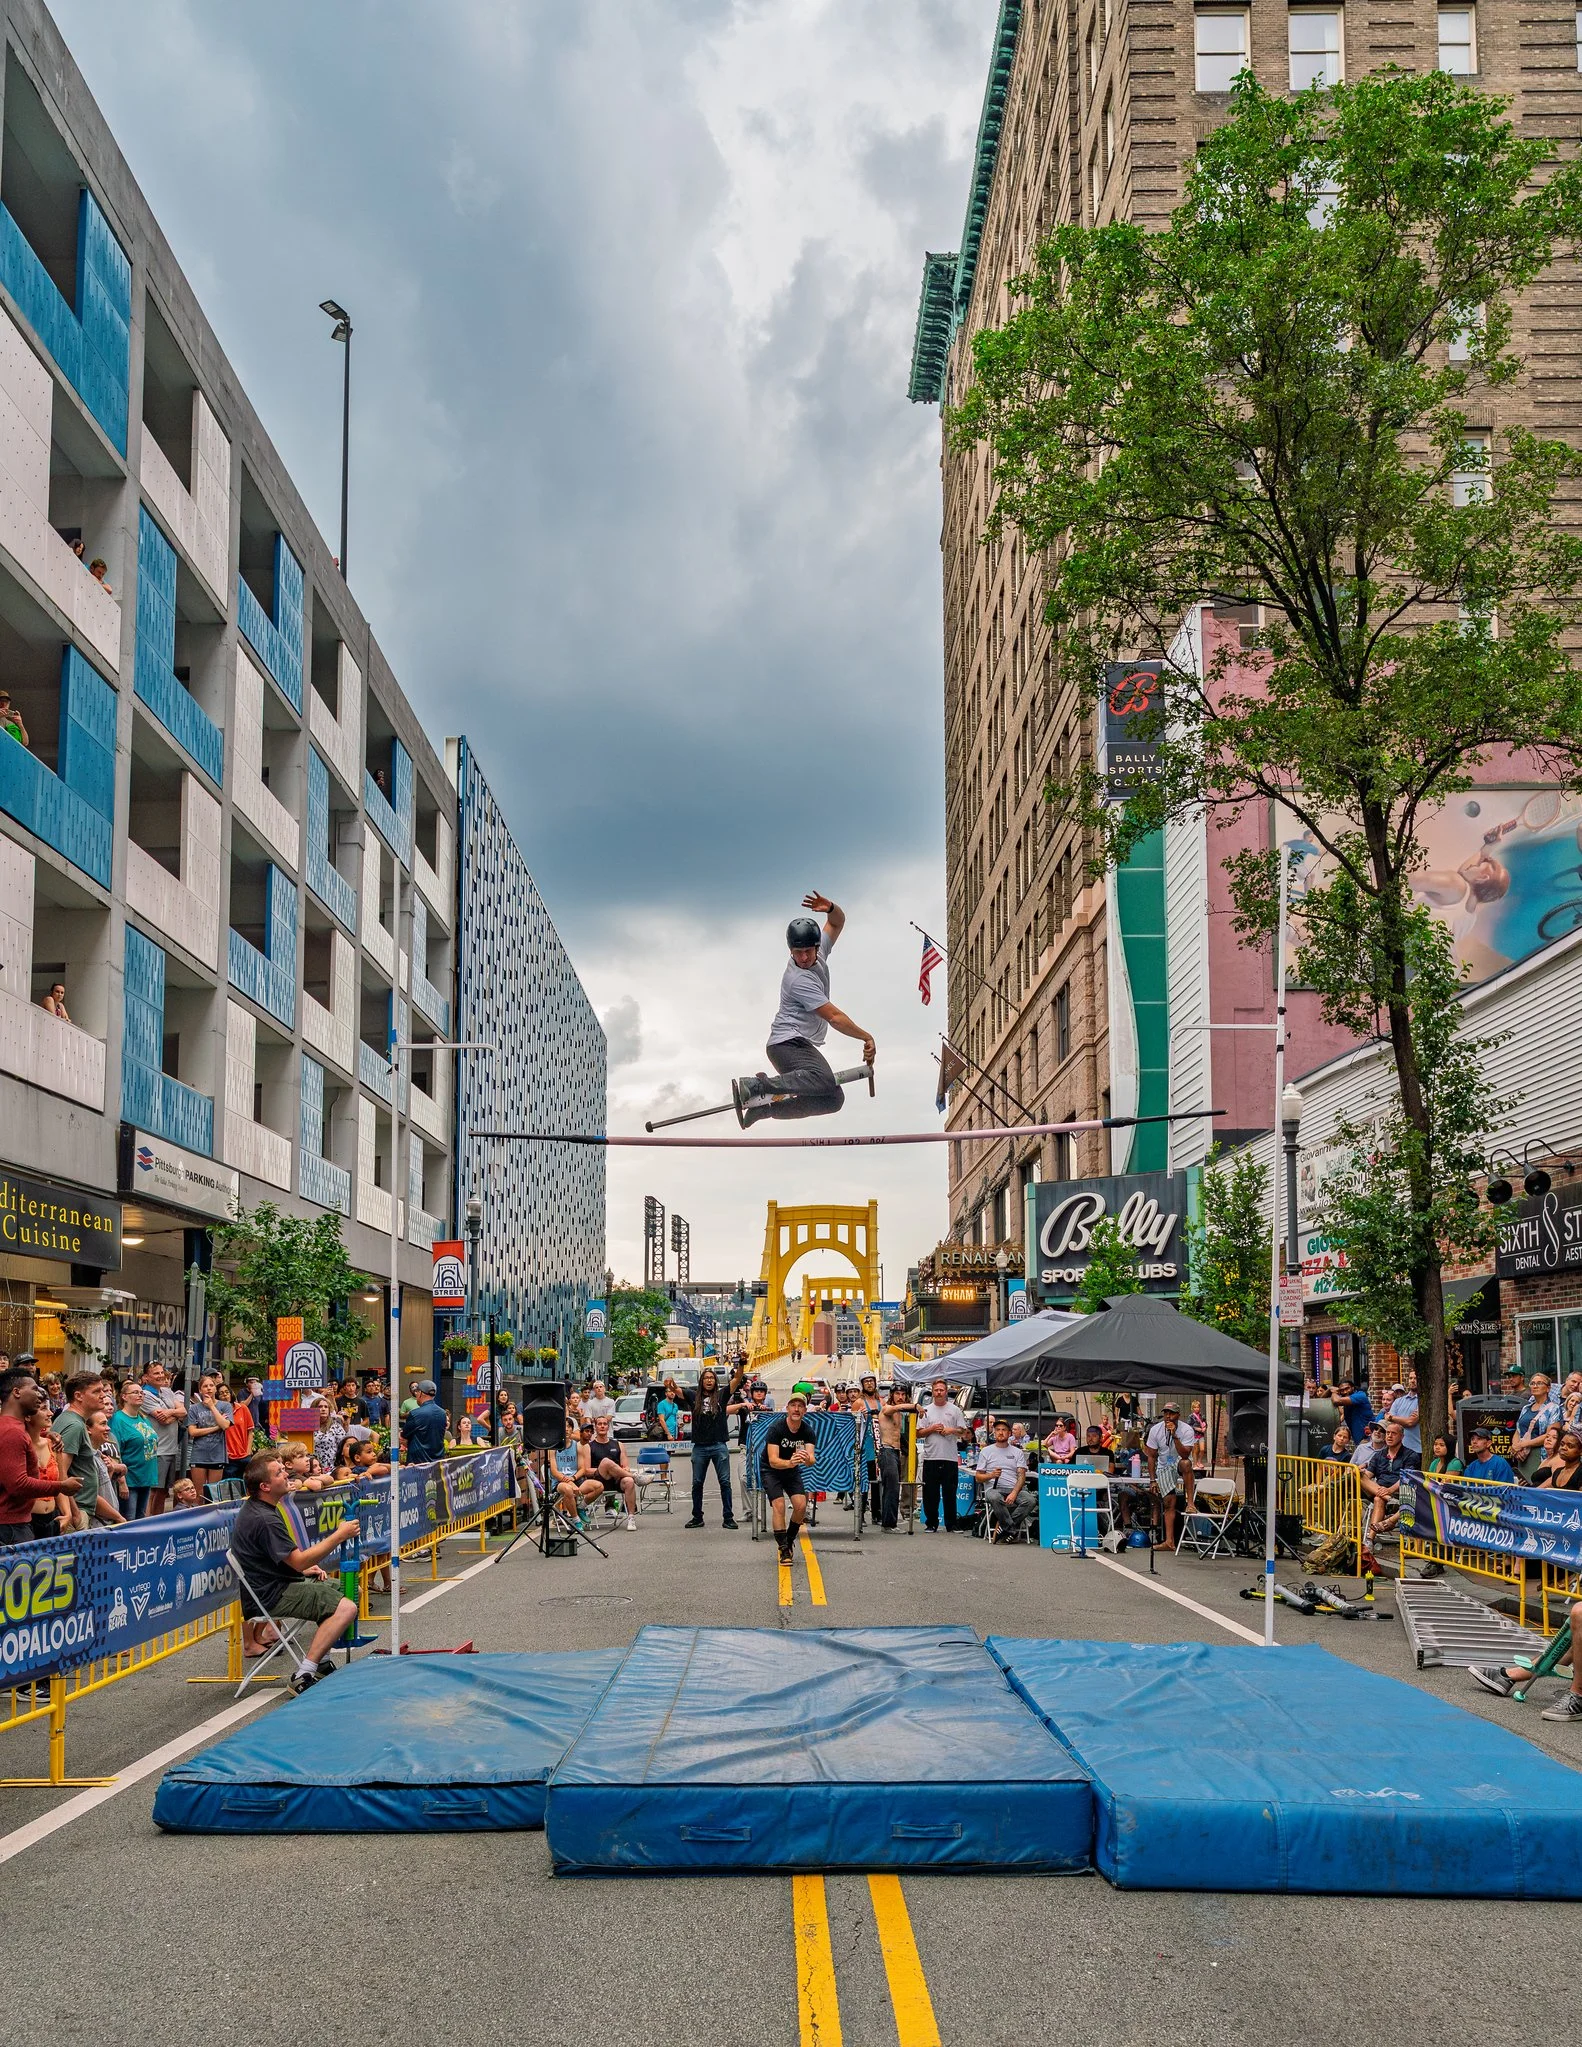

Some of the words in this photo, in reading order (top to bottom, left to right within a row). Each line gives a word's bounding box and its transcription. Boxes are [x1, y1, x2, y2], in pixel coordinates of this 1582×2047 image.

[1109, 766, 1162, 774] SPORTS
[185, 1169, 215, 1189] PARKING
[0, 1181, 113, 1233] diterranean
[2, 1214, 81, 1252] Cuisine
[1039, 1190, 1179, 1259] Blly
[1499, 1219, 1540, 1254] SIXTH
[1515, 1254, 1540, 1270] DENTAL
[943, 1289, 974, 1300] BYHAM
[286, 1379, 321, 1387] STREET
[1522, 1504, 1567, 1524] flybar
[1448, 1518, 1515, 1549] POGOPALOOZA
[109, 1545, 160, 1574] flybar
[207, 1527, 230, 1553] XPOGO
[0, 1553, 75, 1625] 025
[0, 1609, 95, 1665] OPALOOZA
